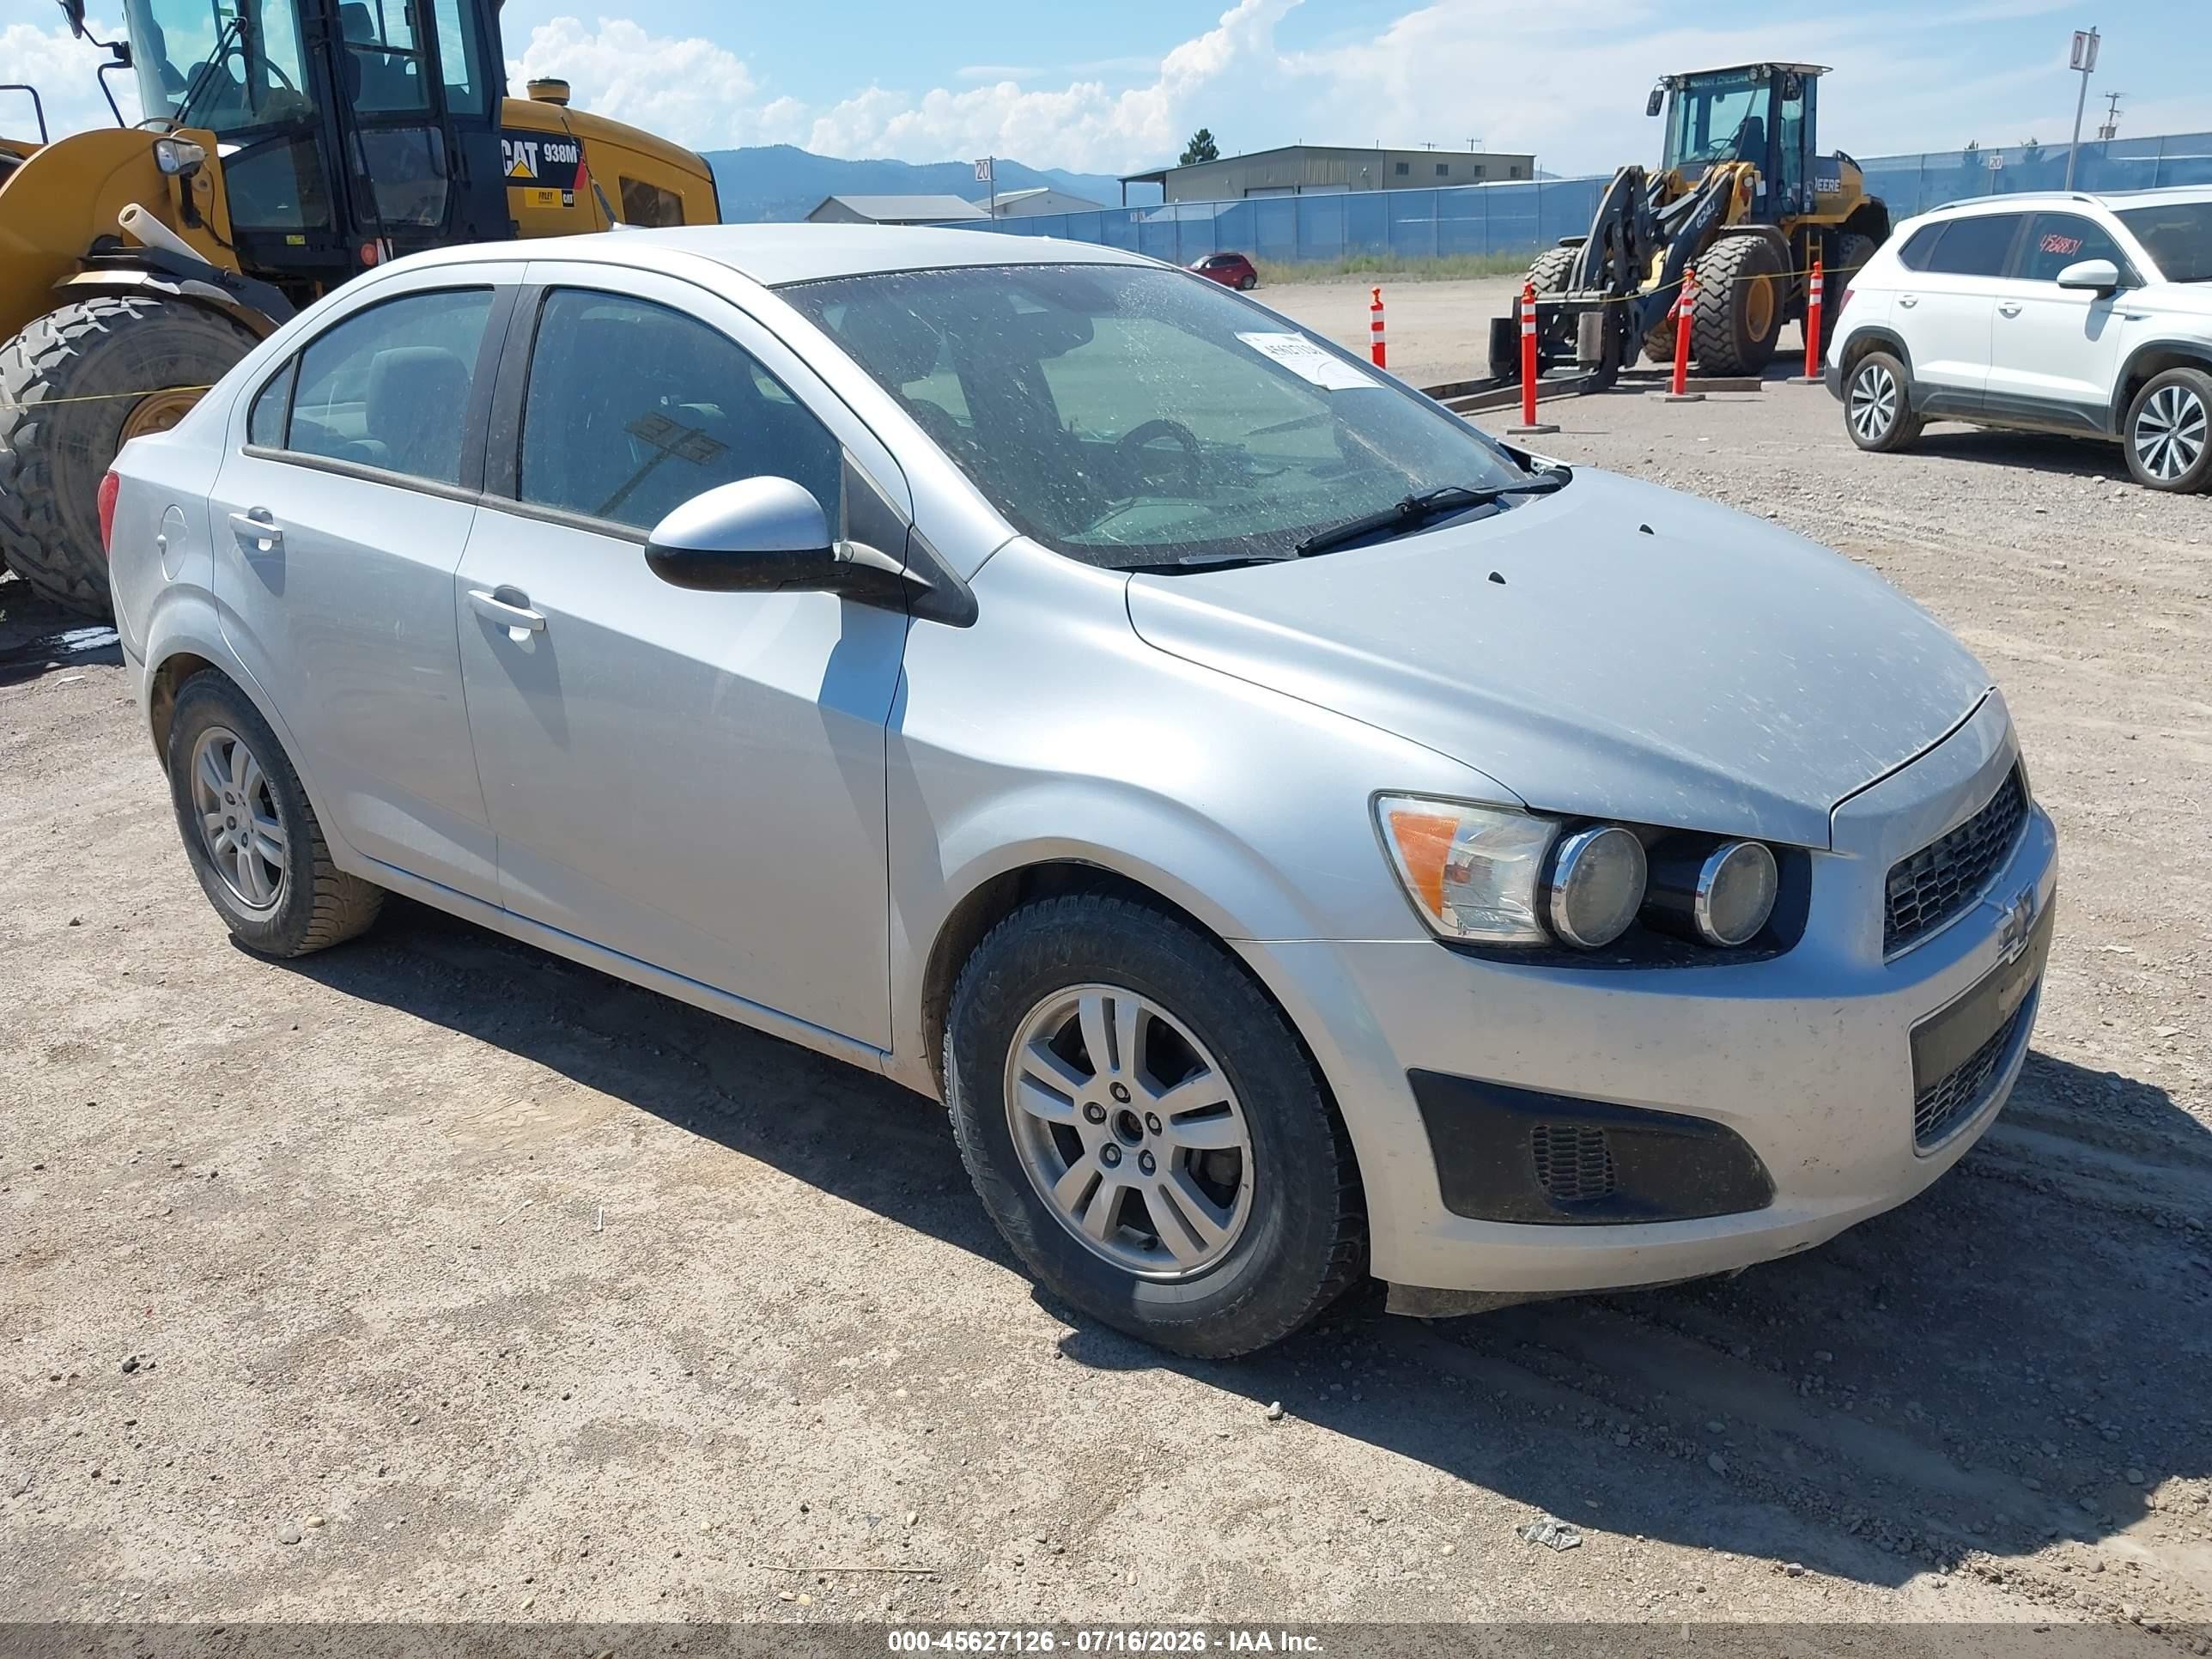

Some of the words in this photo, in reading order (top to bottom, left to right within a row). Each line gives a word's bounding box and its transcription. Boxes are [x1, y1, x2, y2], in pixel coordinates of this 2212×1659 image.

[501, 139, 538, 179] CAT
[544, 143, 577, 163] 938M
[1990, 156, 2002, 169] 20
[976, 161, 988, 179] 20
[562, 192, 574, 204] CAT
